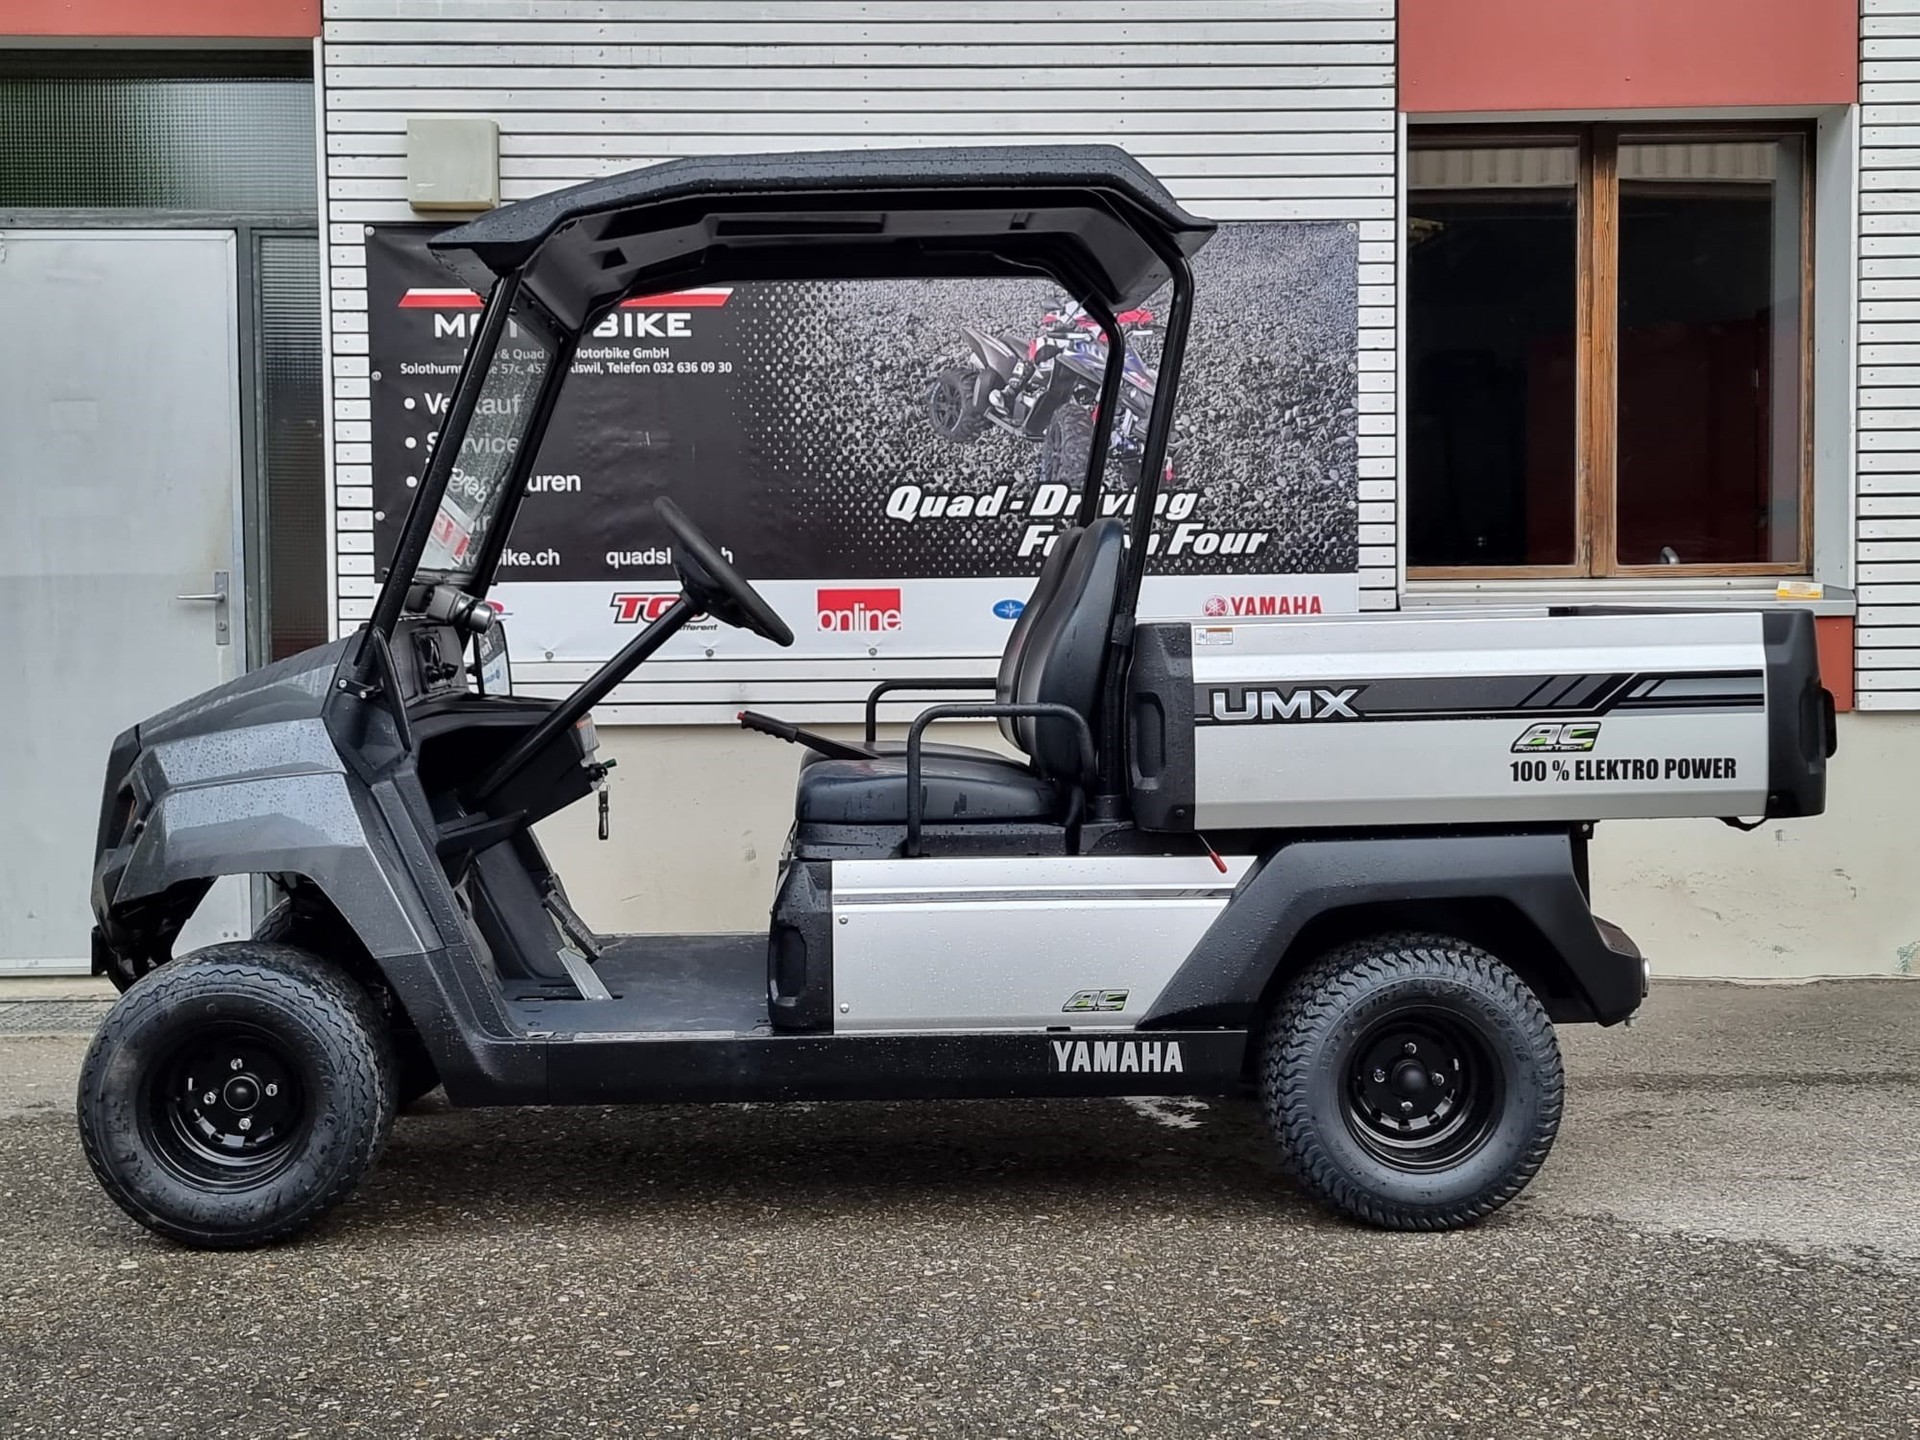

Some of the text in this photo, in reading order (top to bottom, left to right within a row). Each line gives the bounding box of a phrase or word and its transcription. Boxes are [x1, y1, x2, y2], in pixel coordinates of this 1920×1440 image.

[513, 348, 545, 361] Quad
[633, 347, 670, 359] GmbH
[606, 361, 651, 374] Telefon
[653, 361, 674, 374] 032
[677, 361, 698, 374] 636
[701, 361, 715, 374] 09
[718, 361, 733, 374] 30
[885, 485, 1005, 523] Quad
[1167, 523, 1269, 555] Four
[817, 602, 902, 632] online
[1229, 595, 1323, 616] YAMAHA
[1212, 688, 1361, 721] UMX
[1510, 757, 1737, 782] 100 % ELEKTRO POWER
[1052, 1040, 1184, 1073] YAMAHA
